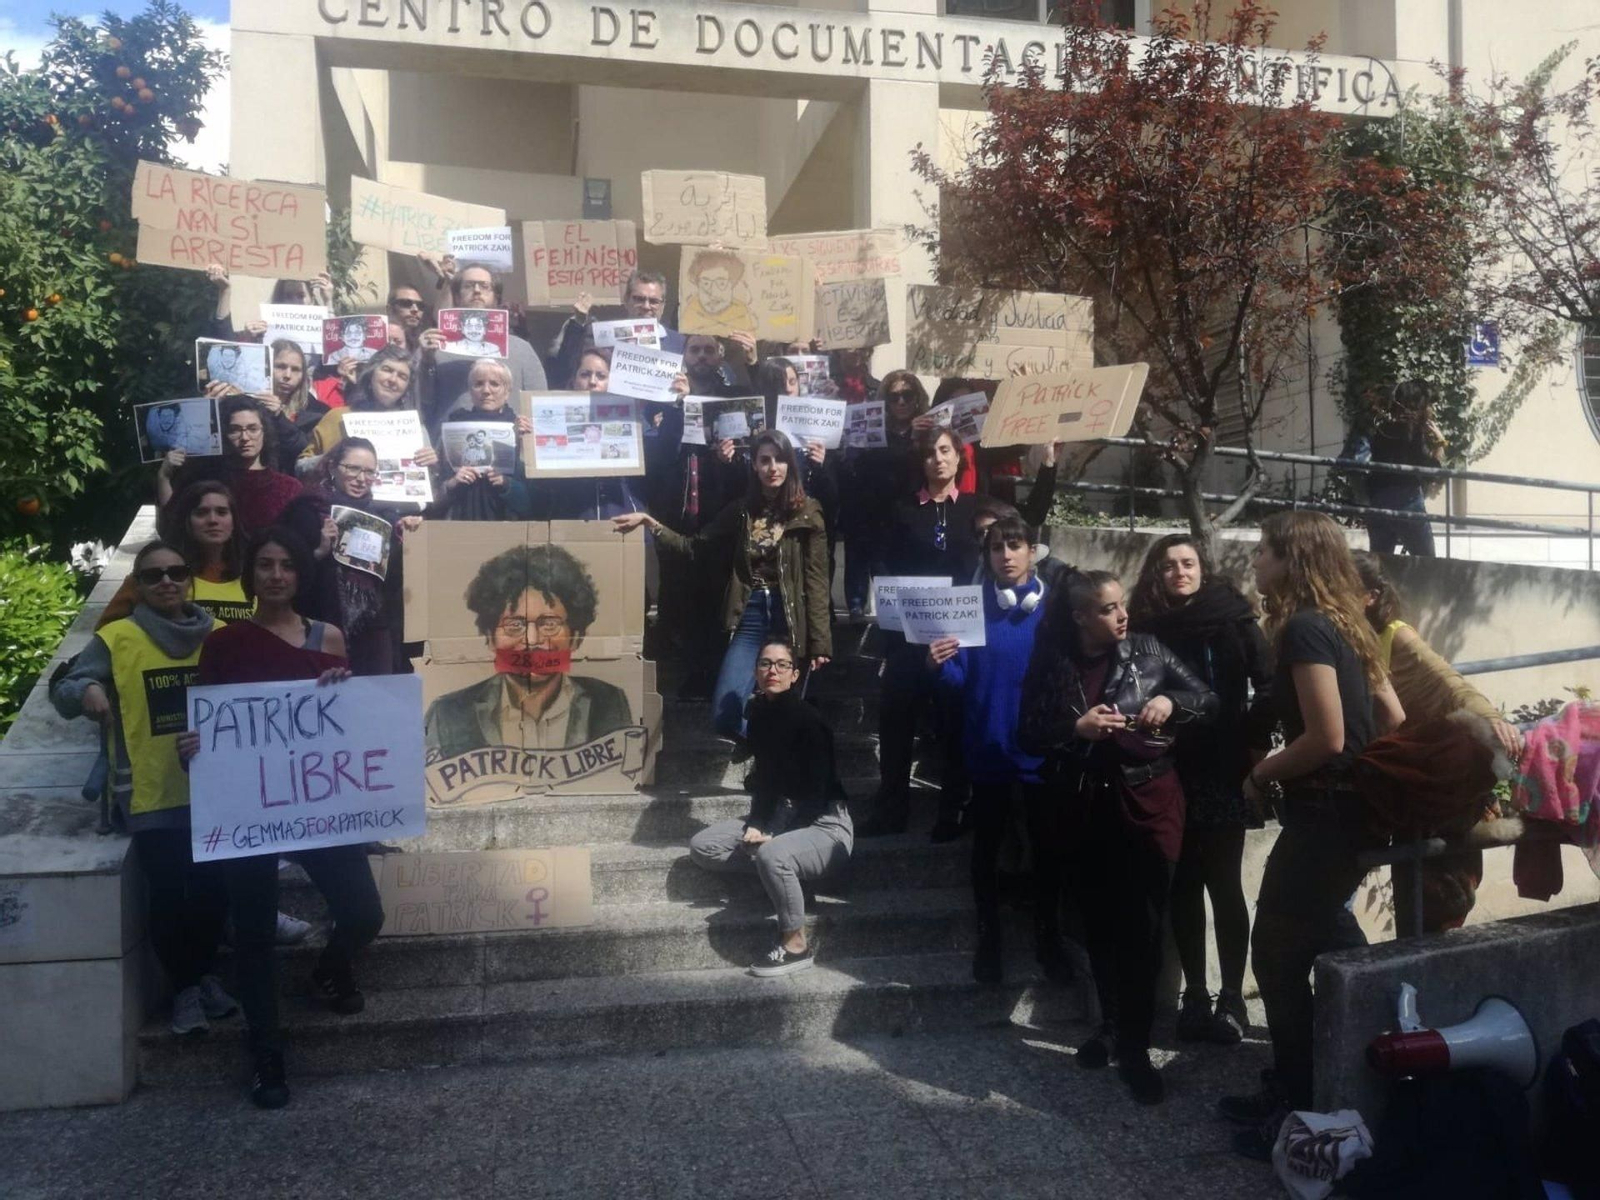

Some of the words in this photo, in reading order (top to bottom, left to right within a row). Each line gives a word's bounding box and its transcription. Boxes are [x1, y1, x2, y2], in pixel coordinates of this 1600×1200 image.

[317, 0, 552, 39] CENTRO
[590, 6, 659, 49] DE
[696, 14, 1116, 82] DOCUMENTACI
[146, 169, 176, 203] LA
[191, 177, 298, 218] RICERCA
[451, 234, 492, 243] FREEDOM
[494, 233, 511, 241] FOR
[564, 223, 591, 244] EL
[170, 234, 304, 272] ARRESTA
[452, 244, 489, 252] PATRICK
[587, 267, 629, 288] PRES
[616, 346, 658, 365] FREEDOM
[660, 359, 678, 369] FOR
[615, 361, 653, 377] PATRICK
[654, 369, 676, 380] ZAKI
[781, 404, 824, 415] FREEDOM
[825, 408, 843, 417] FOR
[781, 415, 819, 427] PATRICK
[820, 418, 840, 429] ZAKI
[1001, 410, 1053, 438] FREE
[902, 597, 953, 608] FREEDOM
[955, 596, 979, 606] FOR
[904, 609, 949, 621] PATRICK
[952, 609, 977, 620] ZAKI
[148, 674, 181, 691] 100%
[438, 748, 555, 792] PATRICK
[560, 737, 623, 779] LIBRE
[393, 900, 519, 933] PATRICK
